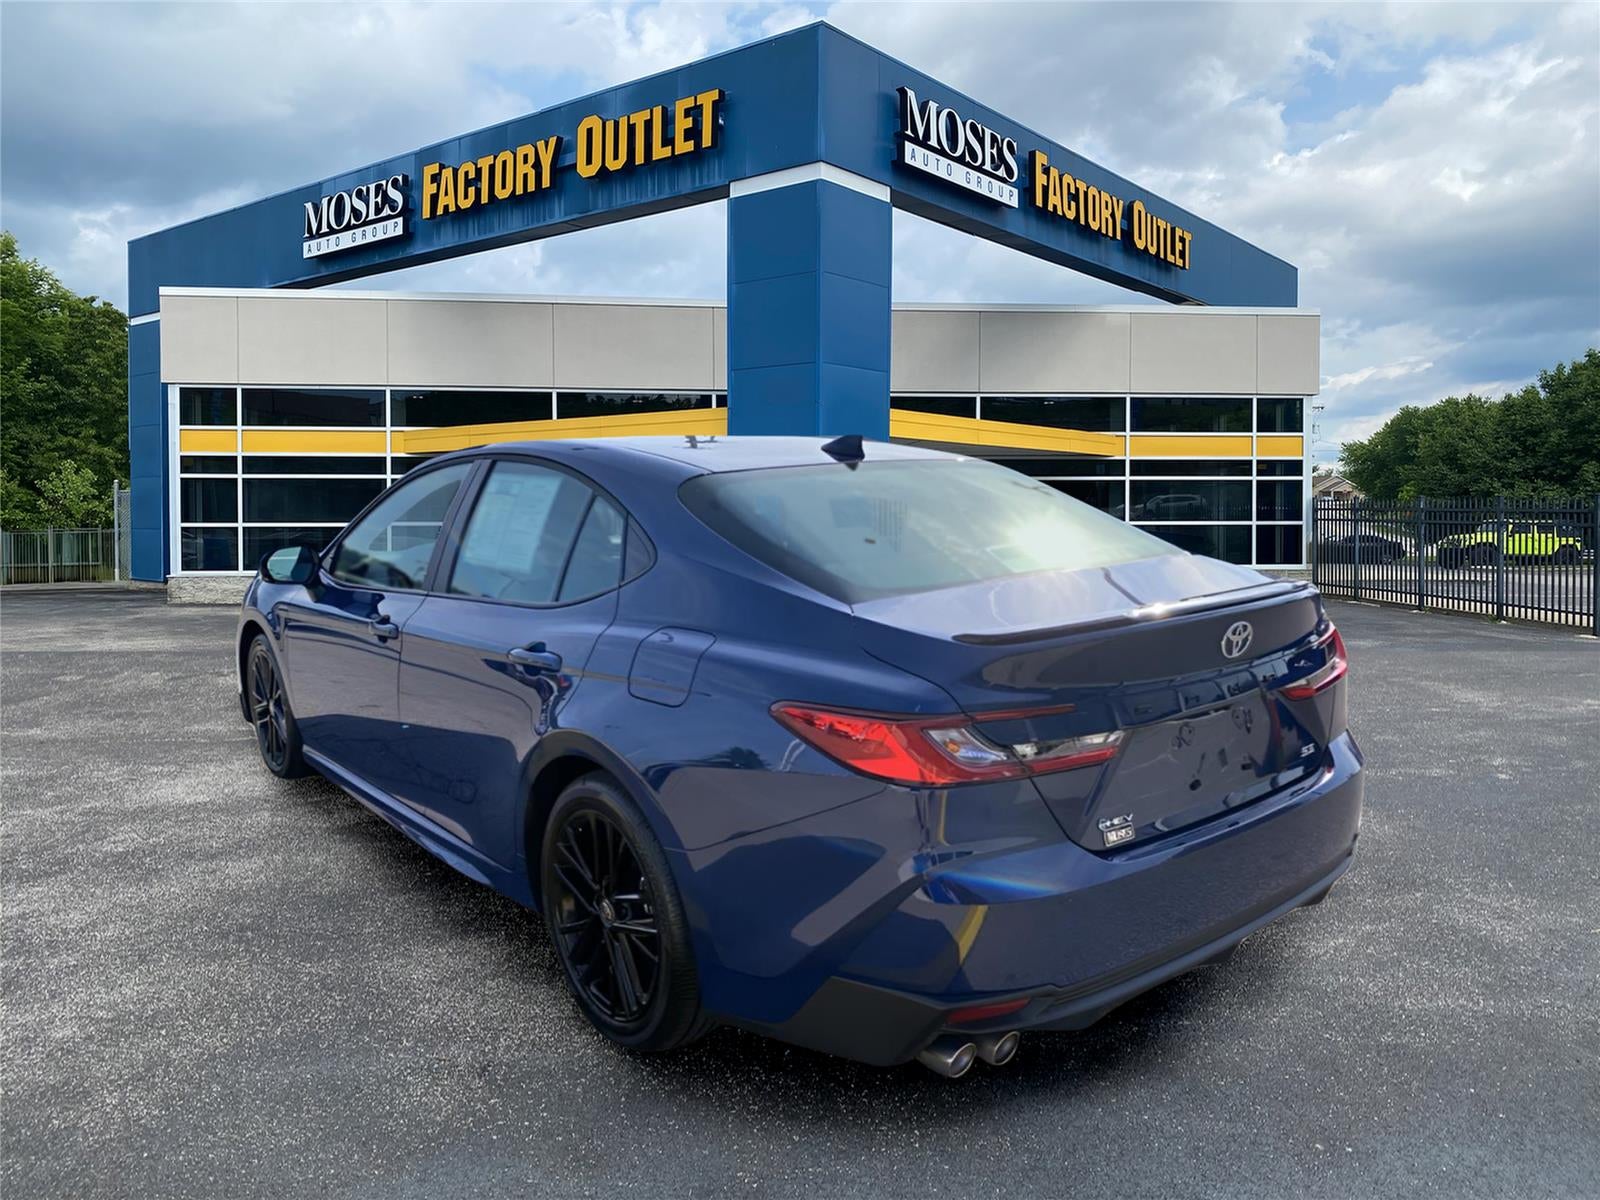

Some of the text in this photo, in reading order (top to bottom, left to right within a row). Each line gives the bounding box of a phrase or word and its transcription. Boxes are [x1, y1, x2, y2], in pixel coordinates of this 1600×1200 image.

[422, 88, 721, 220] FACTORY OUTLET
[903, 86, 1019, 183] MOSES
[910, 147, 1015, 201] AUTO GROUP
[303, 174, 404, 238] MOSES
[307, 221, 399, 254] AUTO GROUP
[1035, 150, 1193, 270] FACTORY OUTLET
